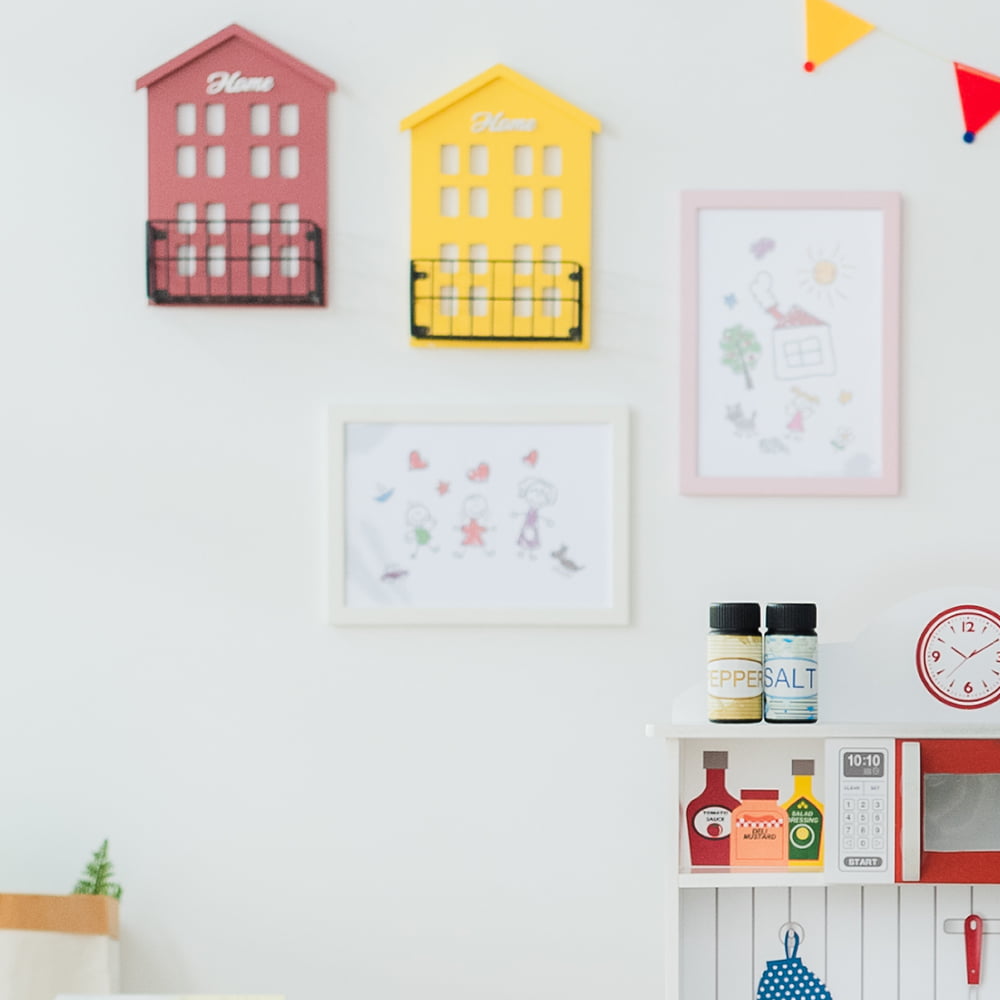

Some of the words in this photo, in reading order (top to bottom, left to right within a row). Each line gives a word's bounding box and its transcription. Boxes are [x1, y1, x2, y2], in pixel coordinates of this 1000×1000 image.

[206, 70, 275, 95] Home
[470, 111, 537, 134] Home
[961, 621, 975, 632] 12
[931, 650, 941, 662] 9
[764, 667, 816, 689] SALT
[963, 682, 973, 694] 6
[848, 754, 880, 767] 10:10
[848, 858, 877, 866] START
